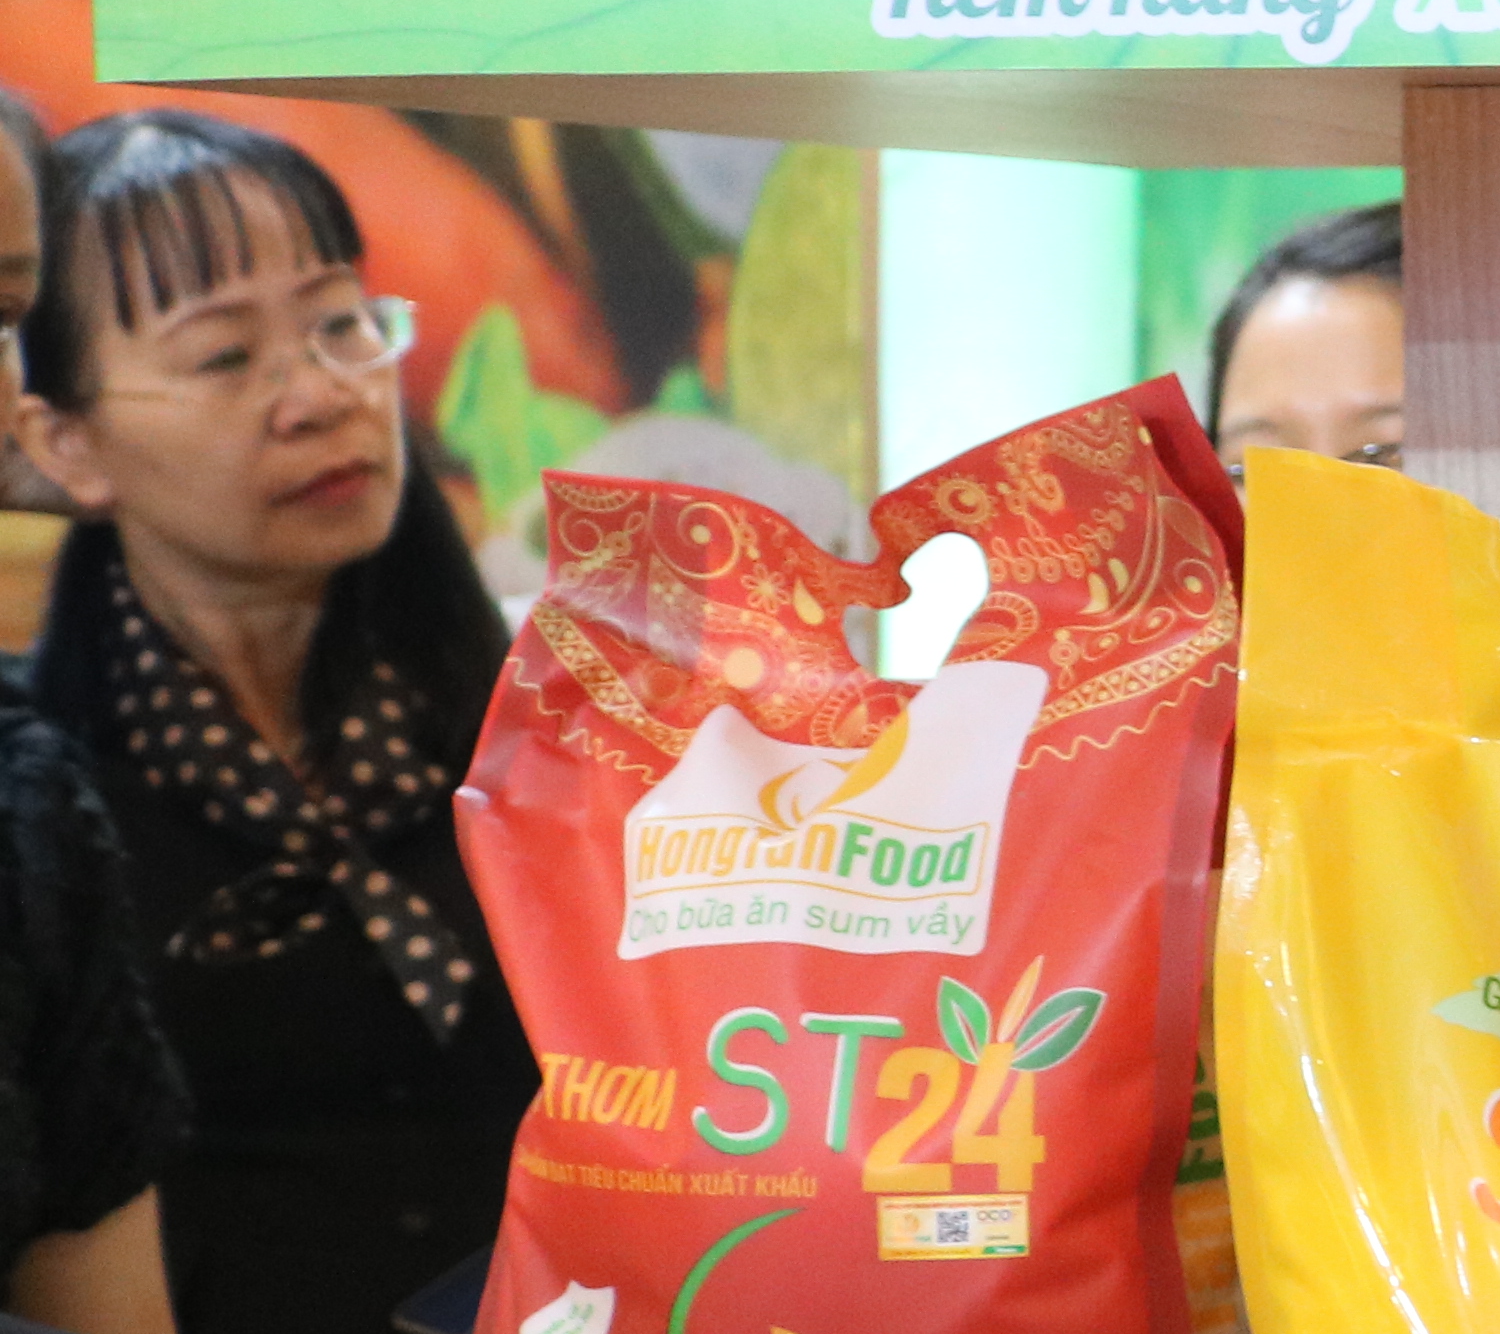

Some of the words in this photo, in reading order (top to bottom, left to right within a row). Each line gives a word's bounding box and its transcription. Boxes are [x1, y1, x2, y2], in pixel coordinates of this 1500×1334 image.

[628, 909, 669, 943] Cho
[675, 897, 736, 931] bữa
[745, 896, 789, 926] ăn
[803, 903, 891, 940] sum
[540, 1052, 678, 1132] THƠM
[690, 1005, 1047, 1194] ST24
[688, 1167, 750, 1197] XUẤT
[754, 1165, 819, 1198] KHẨU
